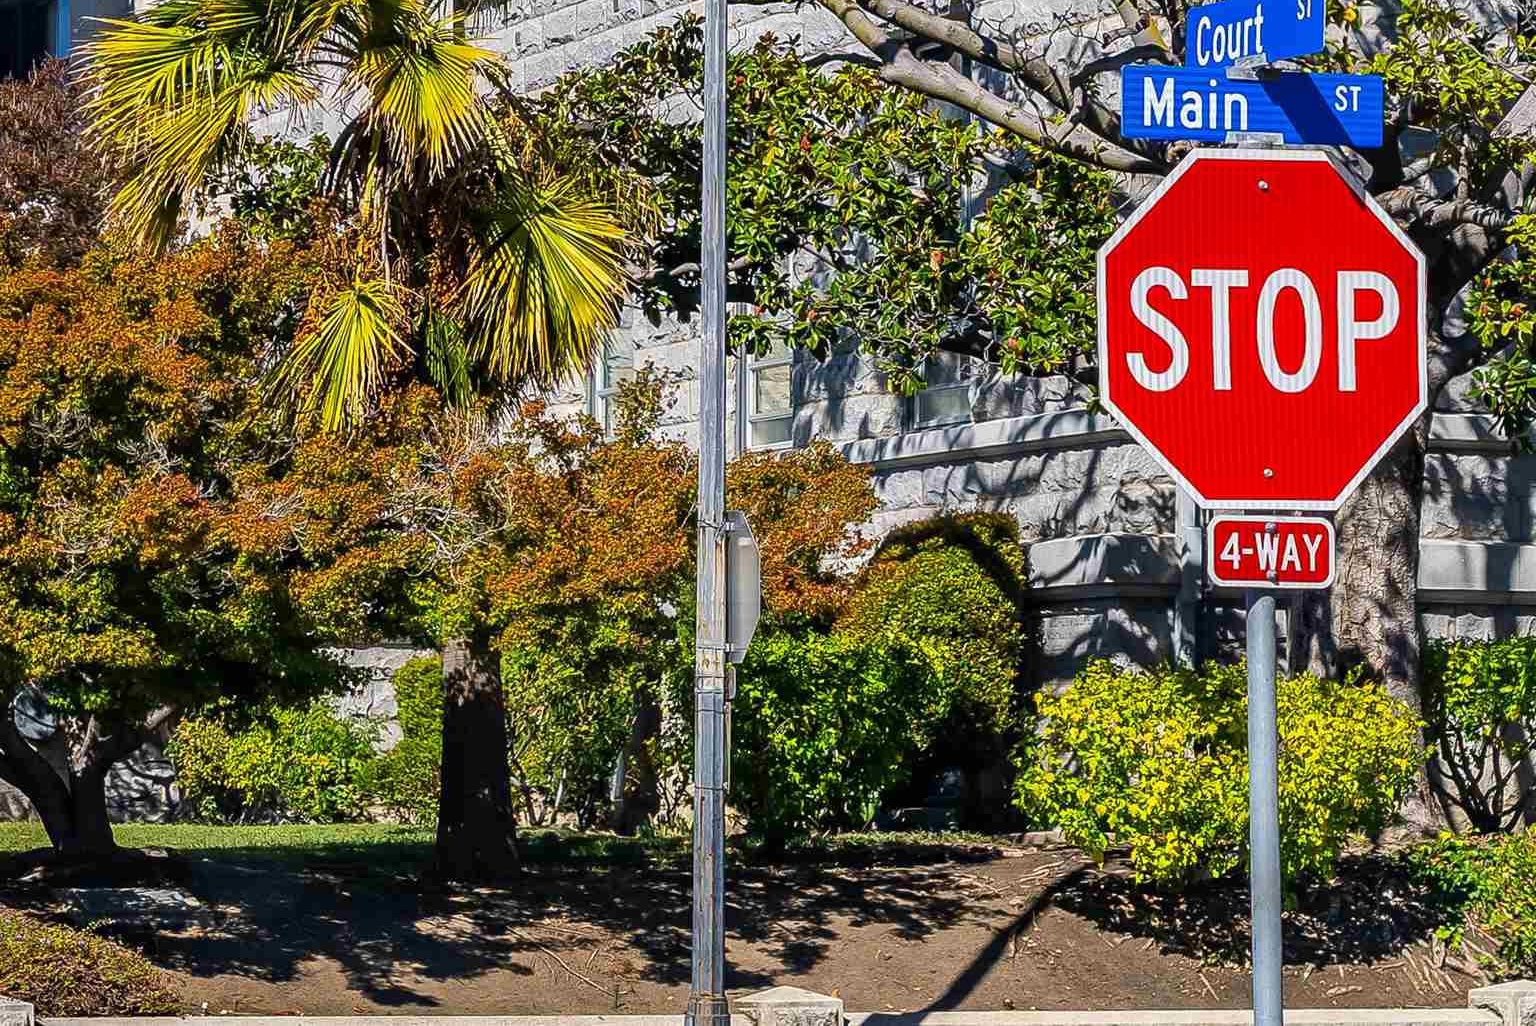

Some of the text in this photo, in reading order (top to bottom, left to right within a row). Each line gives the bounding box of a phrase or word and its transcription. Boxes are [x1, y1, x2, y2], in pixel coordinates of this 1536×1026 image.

[1197, 4, 1264, 66] Court
[1144, 77, 1361, 131] Main ST
[1126, 266, 1400, 393] STOP
[1220, 532, 1322, 572] 4-WAY
